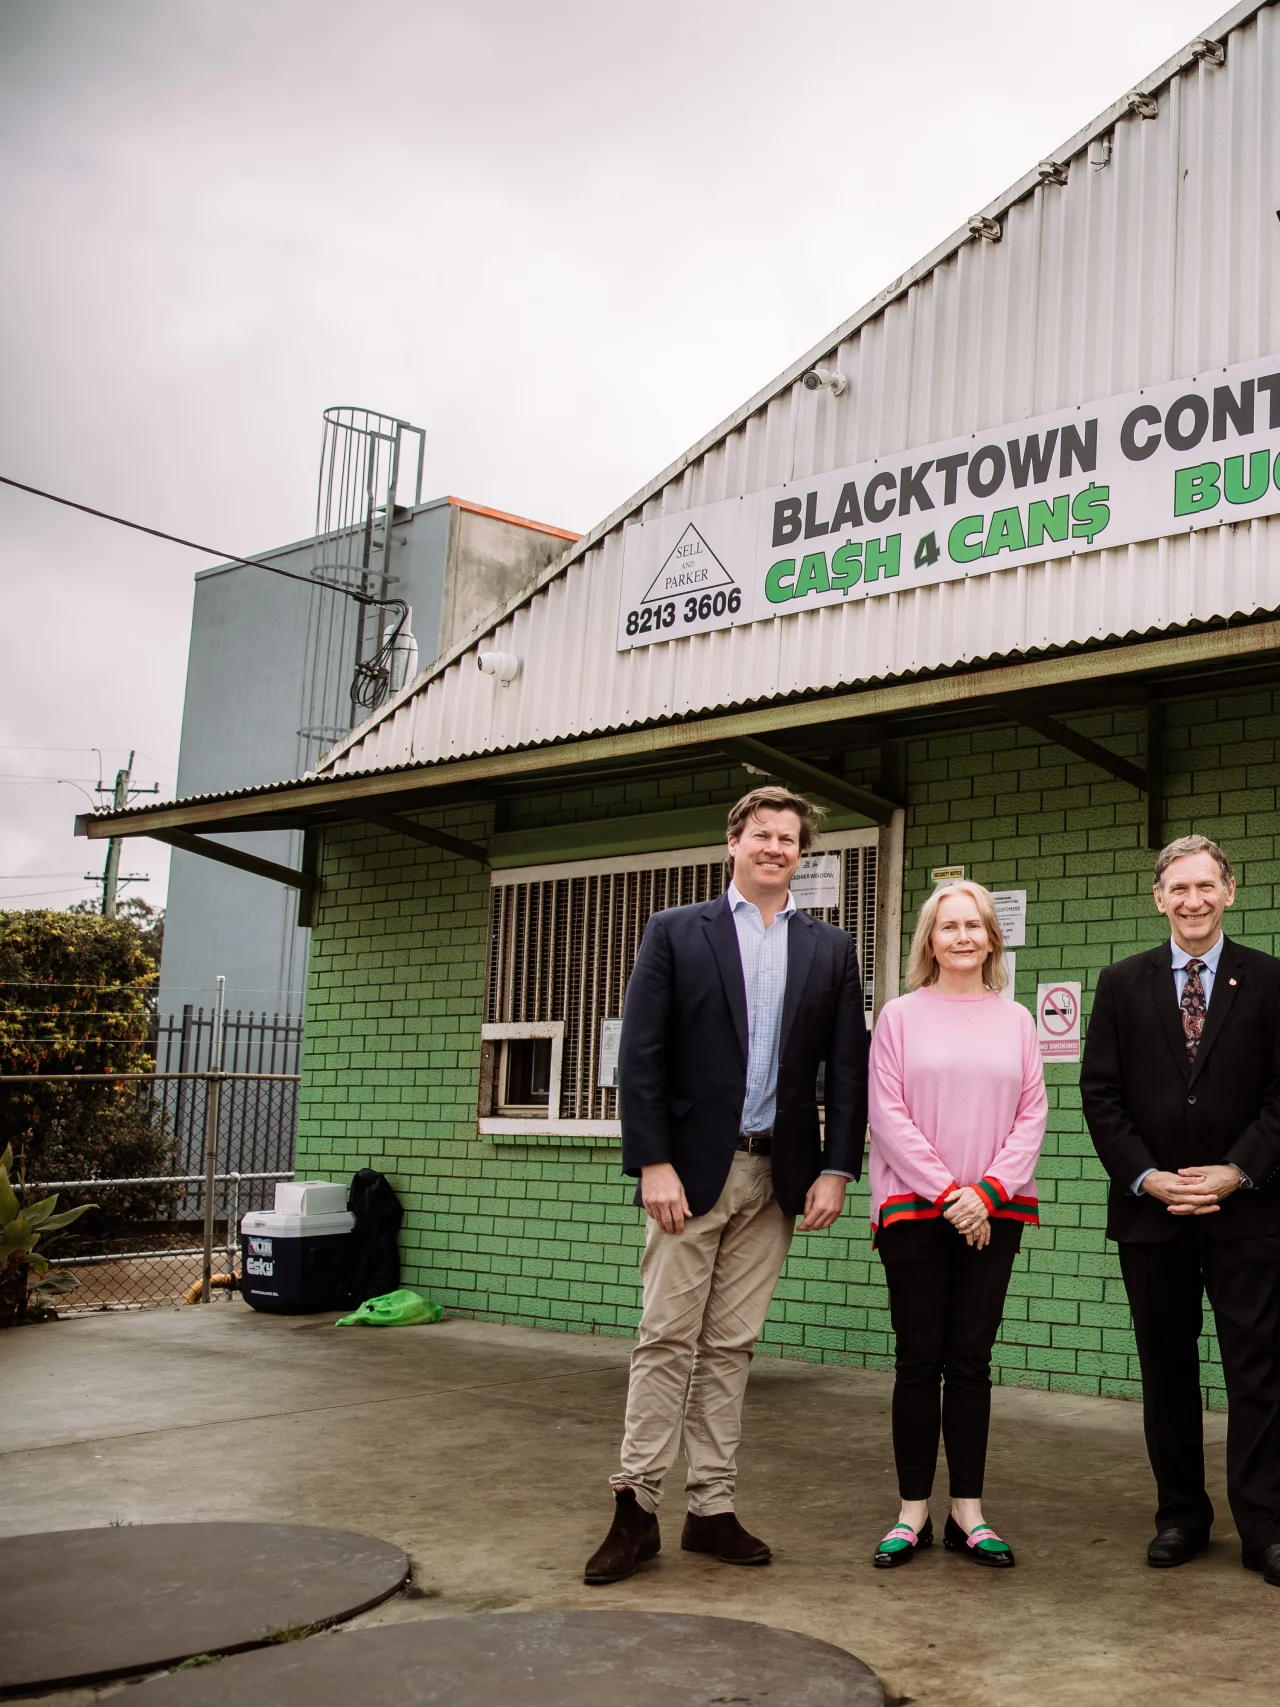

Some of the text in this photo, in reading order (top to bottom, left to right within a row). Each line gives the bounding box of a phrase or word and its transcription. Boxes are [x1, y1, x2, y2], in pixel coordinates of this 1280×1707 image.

[772, 418, 1098, 547] BLACKTOWN
[676, 541, 703, 560] SELL
[765, 533, 902, 603] CA$H
[913, 530, 941, 570] 4
[948, 482, 1111, 563] CAN$
[681, 561, 695, 570] AND
[664, 569, 709, 590] PARKER
[625, 587, 742, 637] 8213 3606
[246, 1257, 274, 1276] Esky
